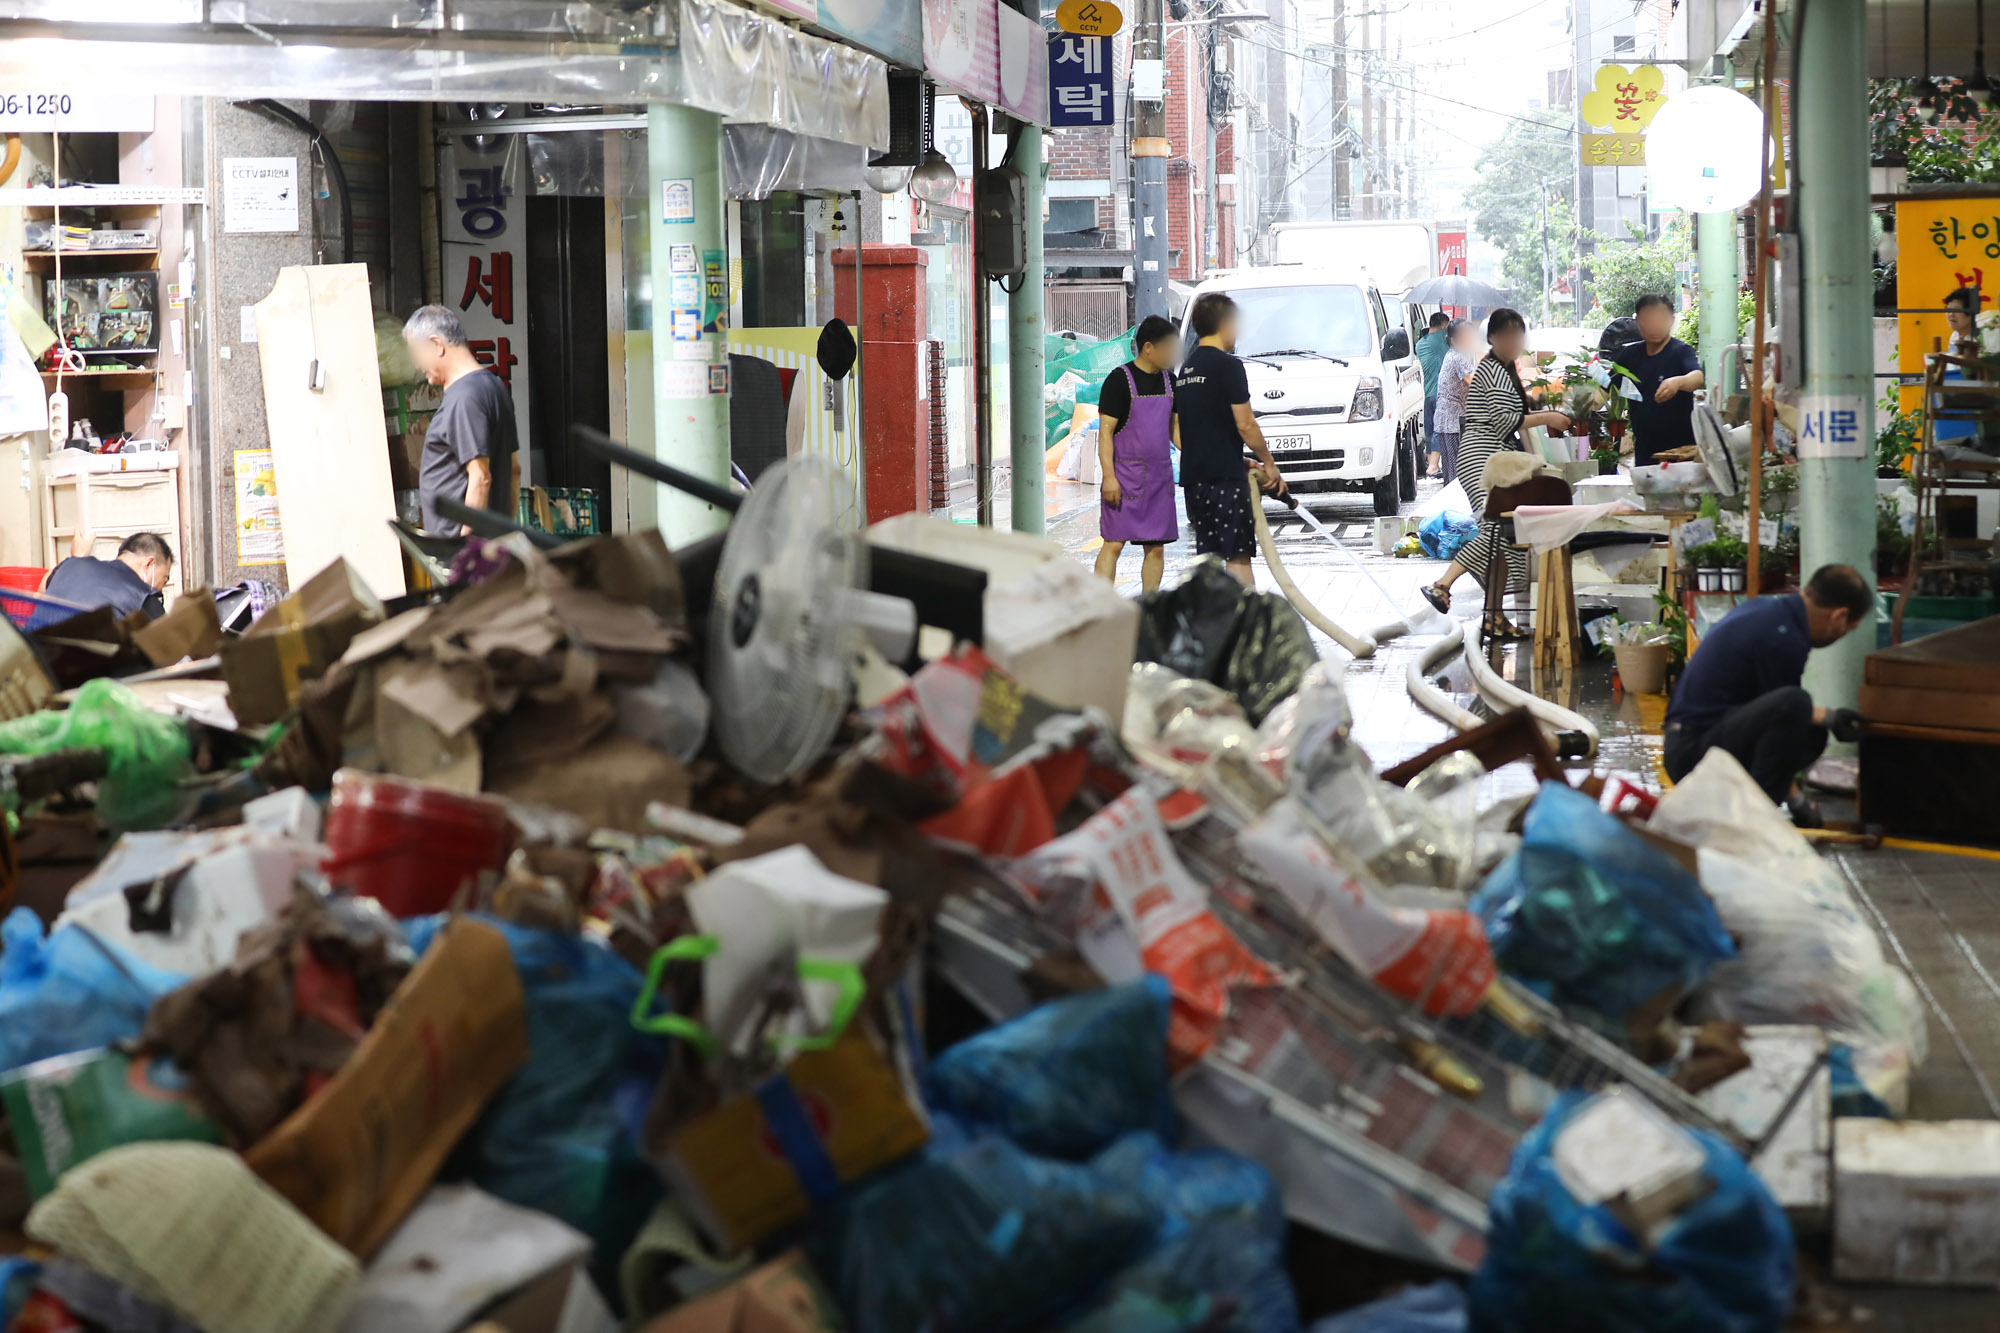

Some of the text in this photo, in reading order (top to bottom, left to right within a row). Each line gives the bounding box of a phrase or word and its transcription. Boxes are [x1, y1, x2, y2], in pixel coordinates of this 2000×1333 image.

[1080, 24, 1099, 32] CCTV
[1055, 36, 1109, 121] 세탁
[1614, 82, 1643, 121] 꽃
[1275, 437, 1304, 449] 2887
[1802, 410, 1858, 443] 서문
